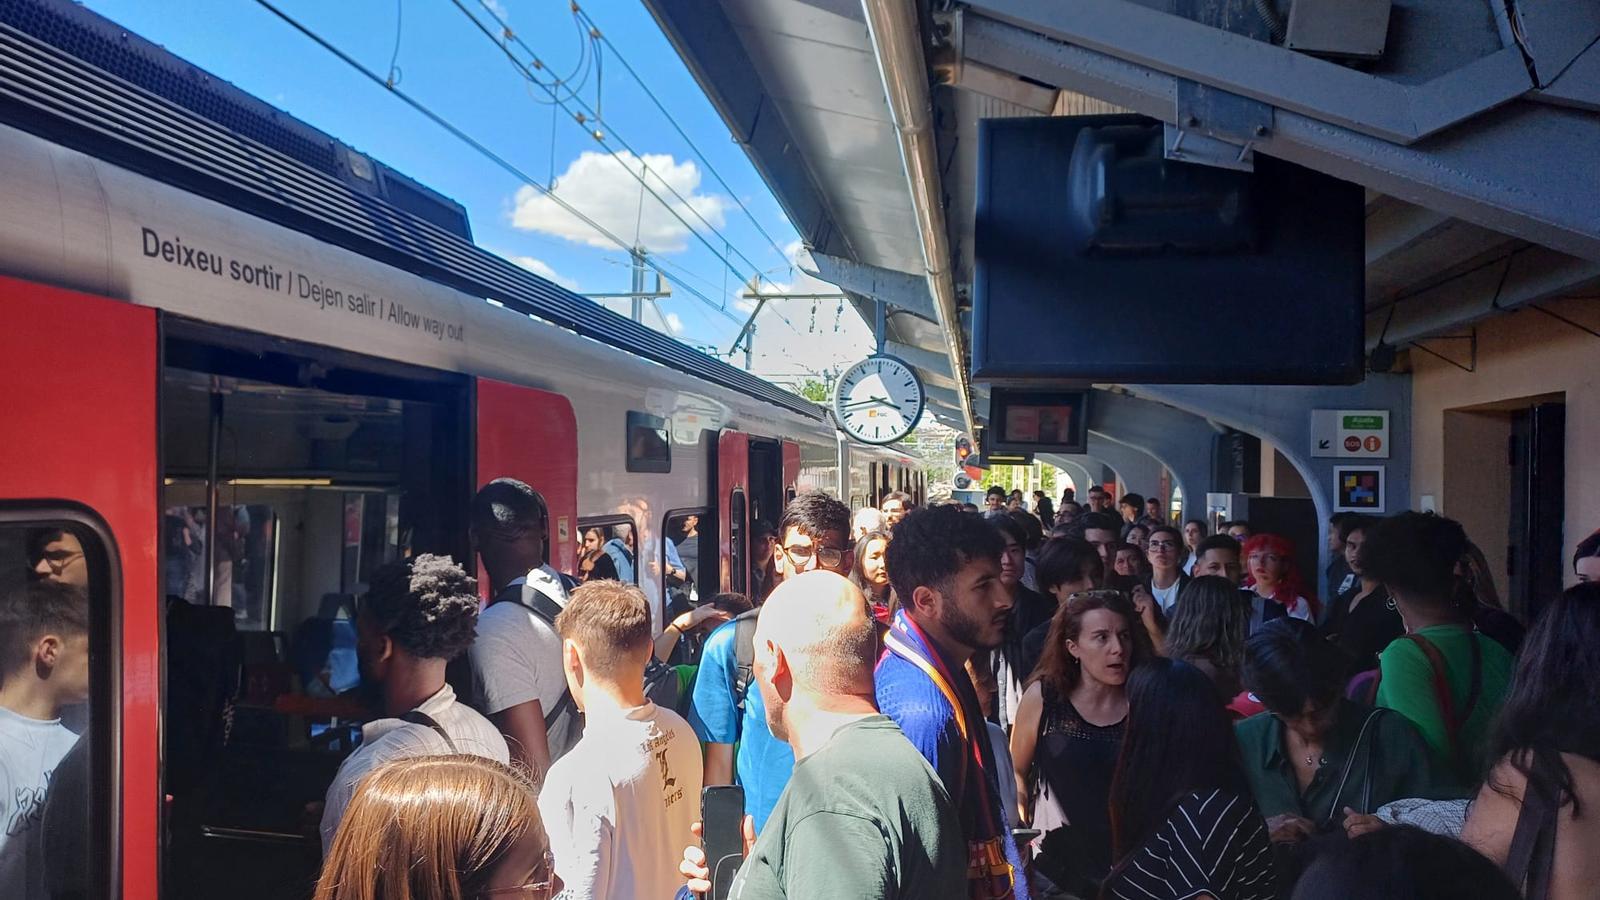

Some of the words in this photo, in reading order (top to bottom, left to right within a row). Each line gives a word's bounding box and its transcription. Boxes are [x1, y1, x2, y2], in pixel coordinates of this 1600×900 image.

[141, 227, 223, 276] Deixeu
[230, 259, 282, 291] sortir
[298, 274, 344, 310] Dejen
[347, 292, 376, 317] salir
[388, 301, 420, 329] Allow
[422, 316, 446, 341] way
[447, 323, 464, 342] out
